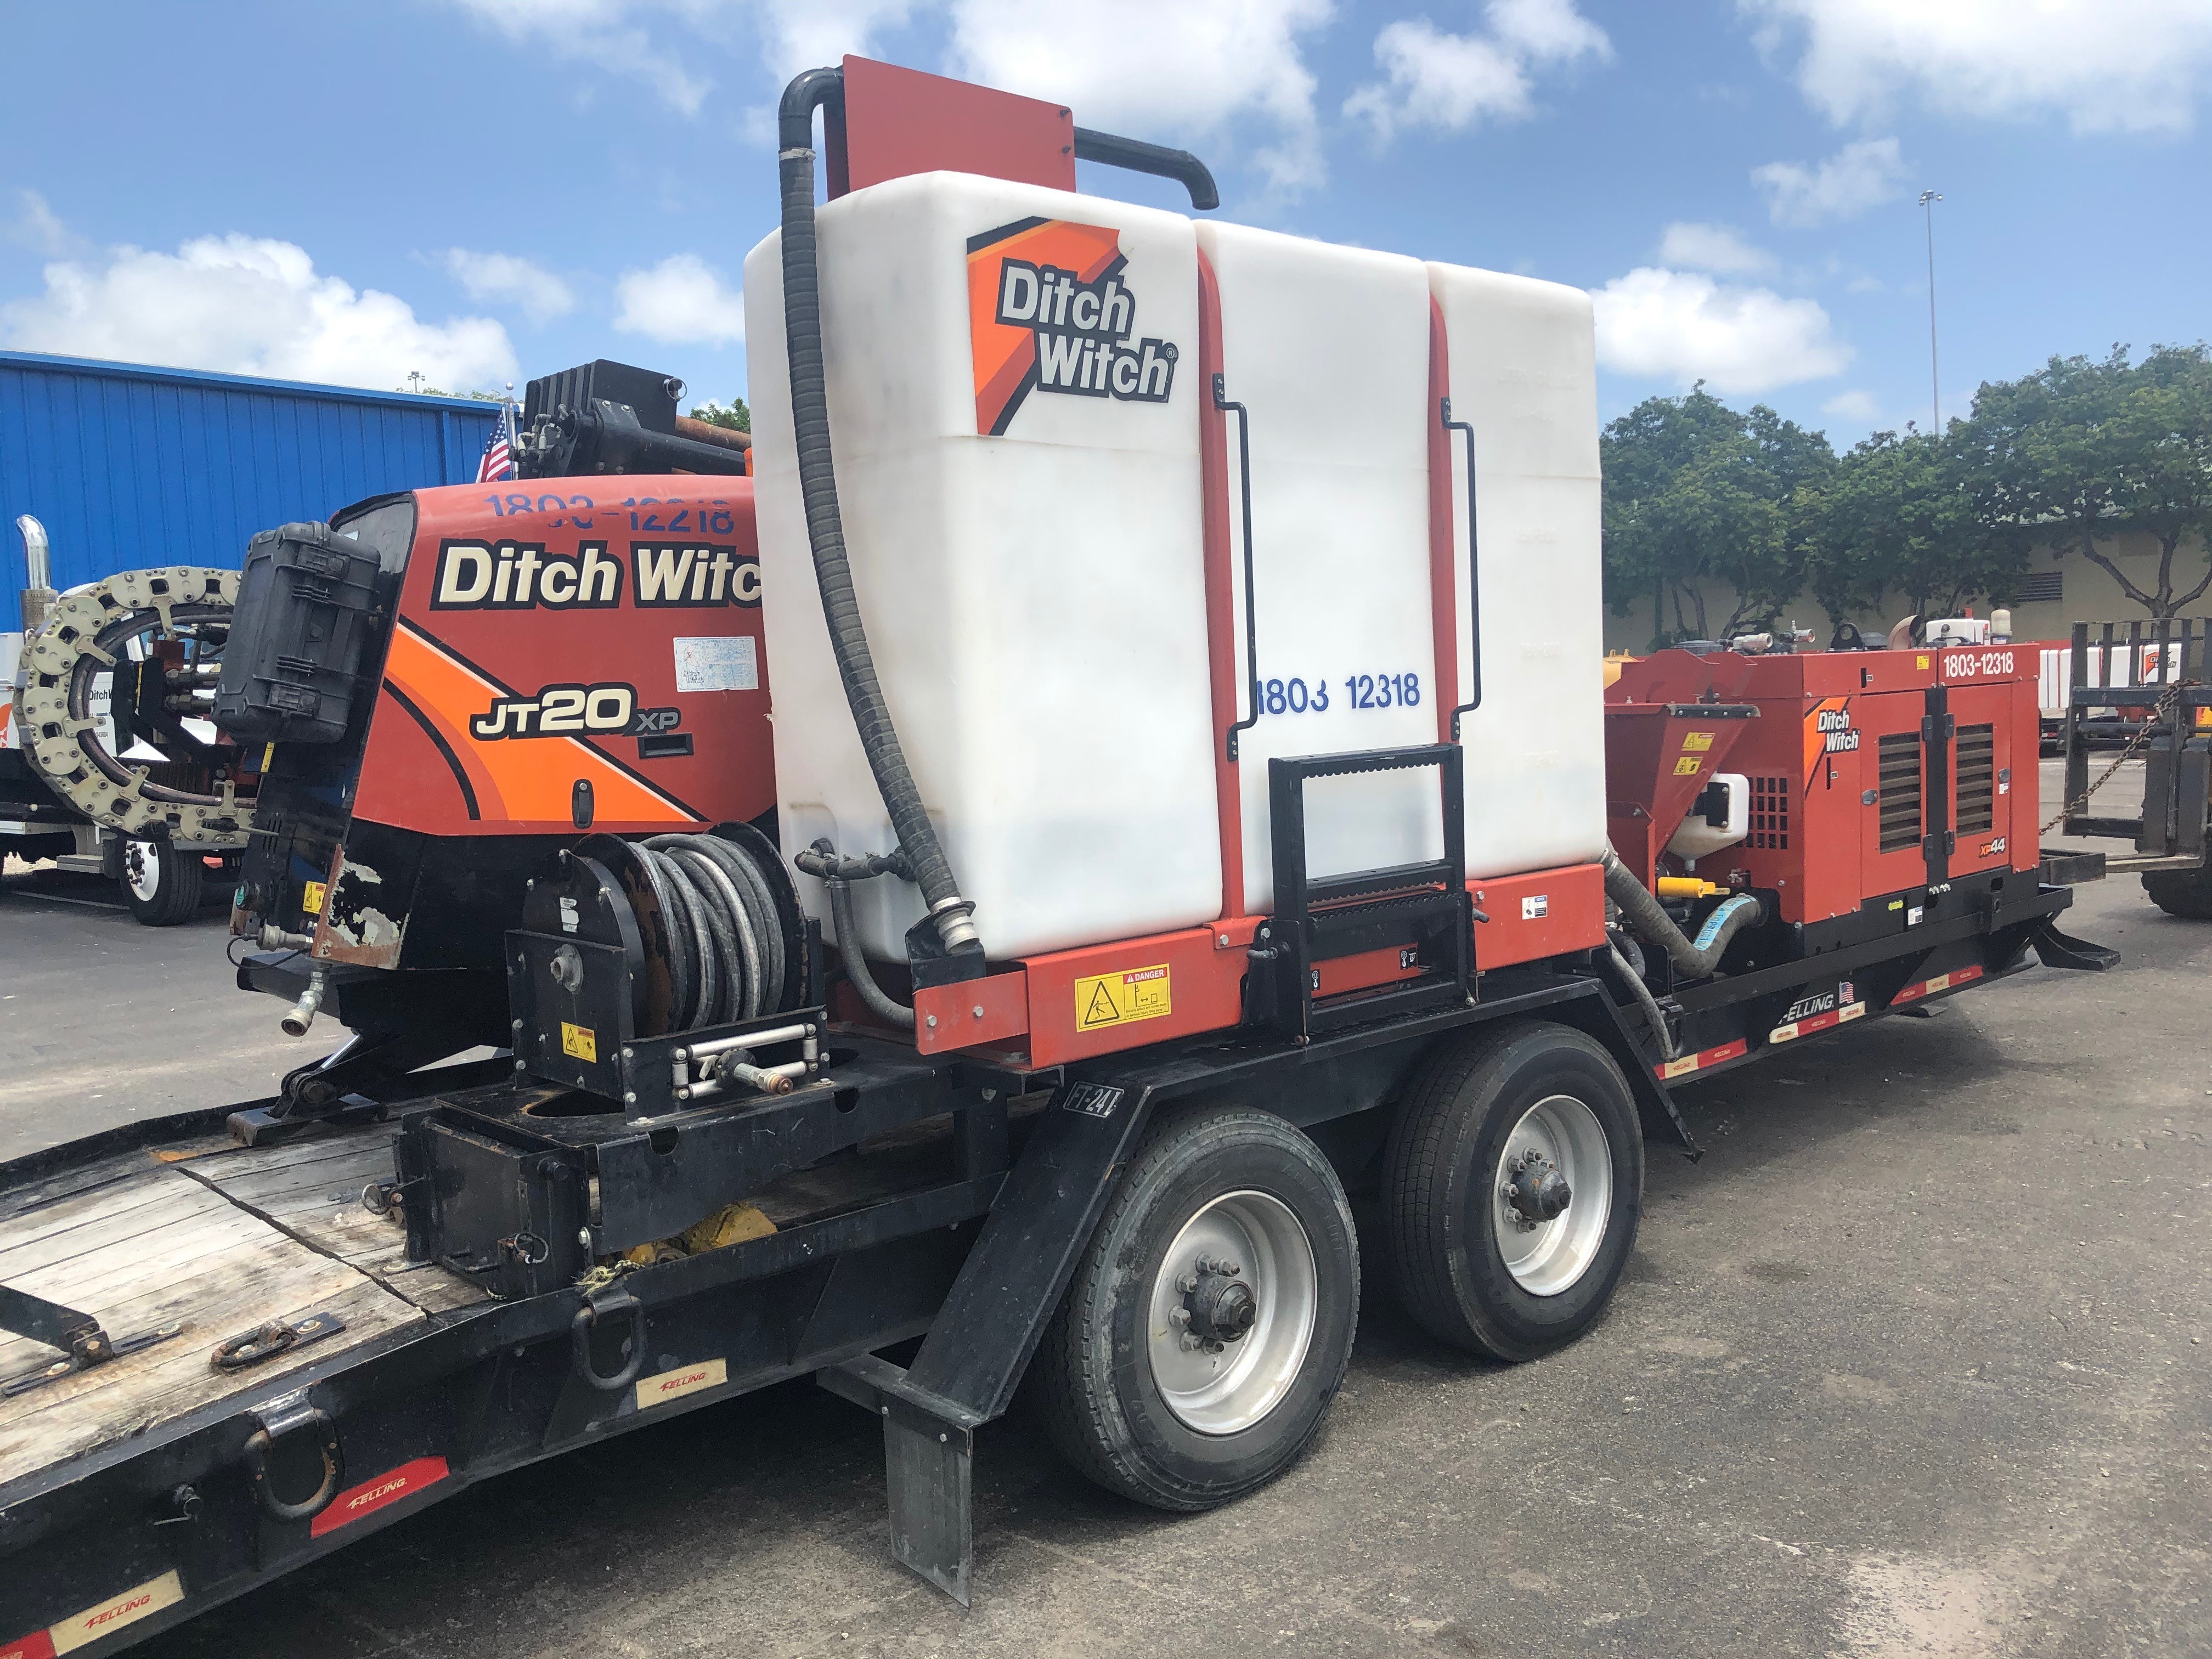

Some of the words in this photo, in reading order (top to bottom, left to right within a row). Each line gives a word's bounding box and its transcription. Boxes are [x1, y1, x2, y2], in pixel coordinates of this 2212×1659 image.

[1002, 266, 1130, 333] Ditch
[439, 546, 618, 602] Ditch
[636, 549, 761, 601] Witc
[1944, 651, 2014, 678] 1803-12318
[1257, 678, 1329, 714] 1803
[1345, 673, 1420, 709] 12318
[476, 689, 631, 734] JT20
[635, 712, 679, 731] XP
[1818, 710, 1850, 731] Ditch
[1826, 730, 1859, 752] Witch
[1135, 969, 1164, 981] DANGER
[659, 1372, 707, 1392] FELLING
[346, 1476, 407, 1510] FELLING
[82, 1594, 151, 1629] FELLING
